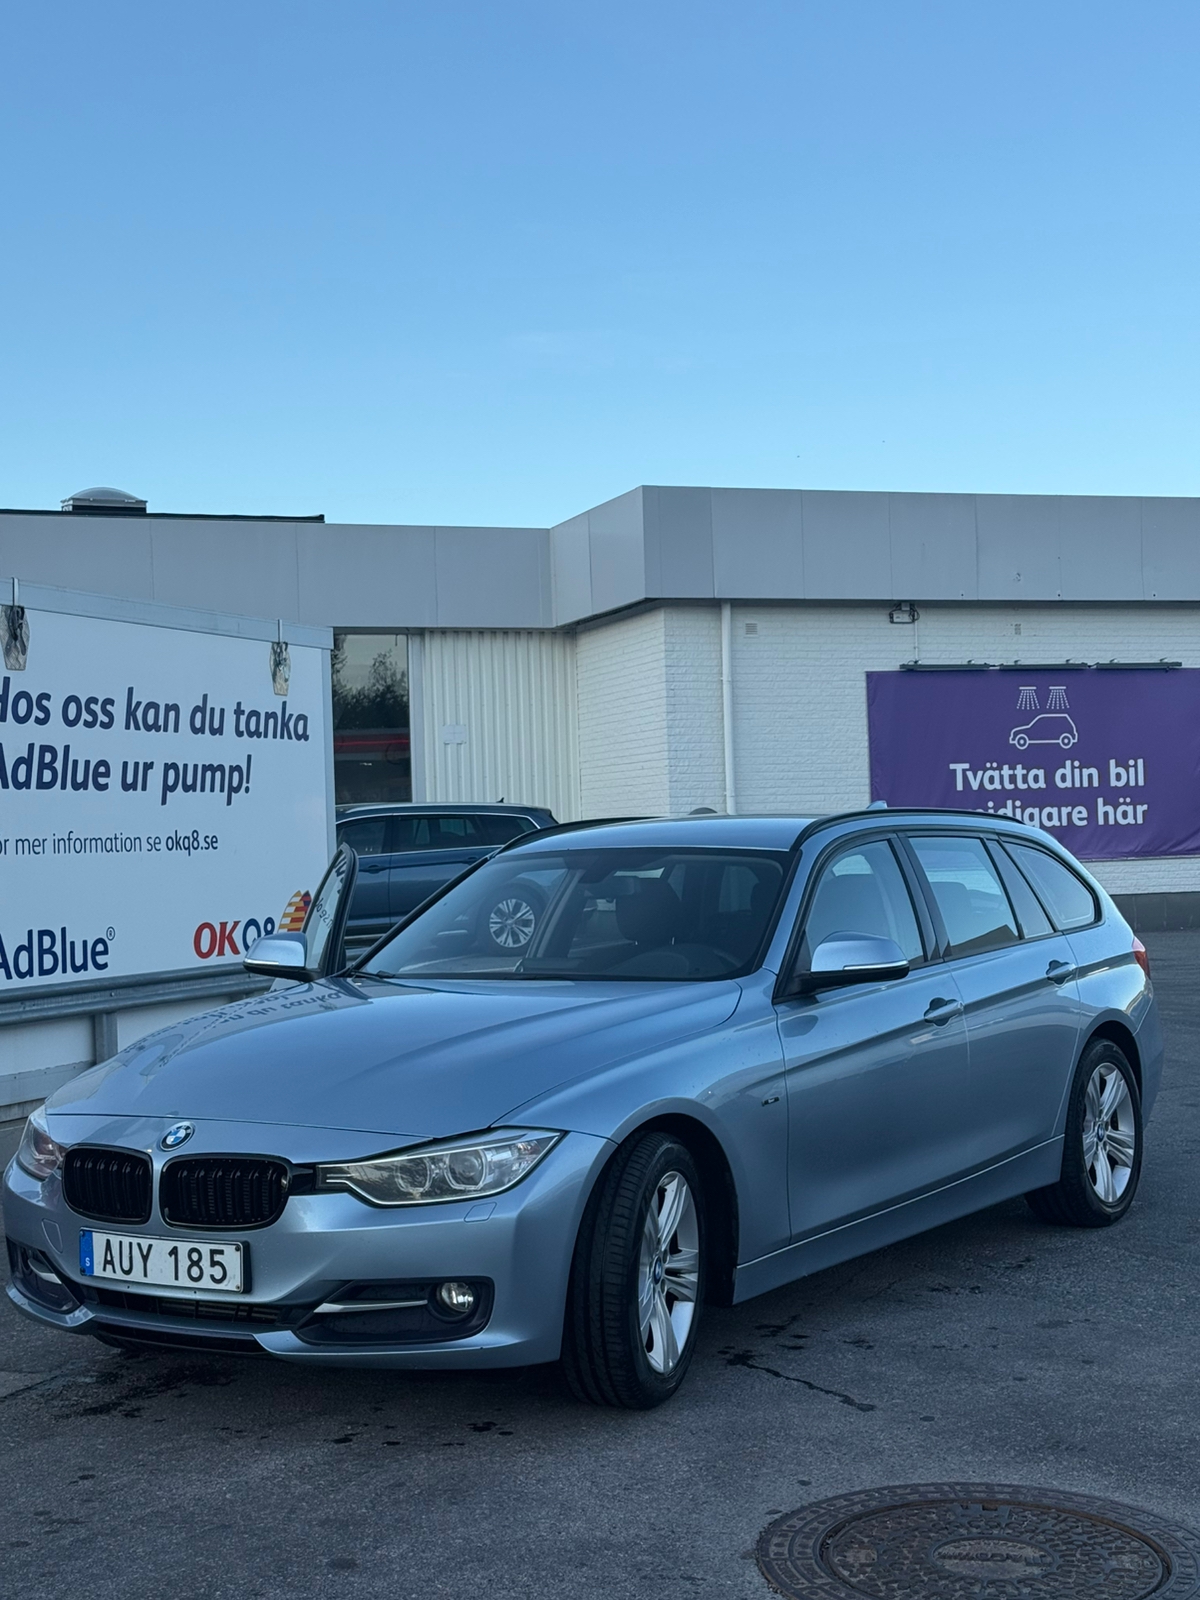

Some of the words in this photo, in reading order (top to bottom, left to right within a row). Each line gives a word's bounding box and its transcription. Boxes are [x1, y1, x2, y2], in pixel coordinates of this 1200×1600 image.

[62, 694, 116, 730] oss
[124, 686, 181, 734] kan
[189, 693, 225, 736] du
[233, 700, 310, 742] tanka
[121, 760, 155, 792] ur
[160, 753, 252, 806] pump!
[949, 762, 1046, 791] Tvätta
[1054, 760, 1100, 789] din
[1109, 758, 1145, 787] bil
[1097, 797, 1148, 826] här
[15, 838, 48, 856] mer
[52, 830, 142, 854] information
[146, 836, 162, 852] se
[165, 829, 219, 857] okq8.se
[85, 1257, 91, 1267] S
[102, 1238, 153, 1278] AUY
[168, 1245, 228, 1285] 185
